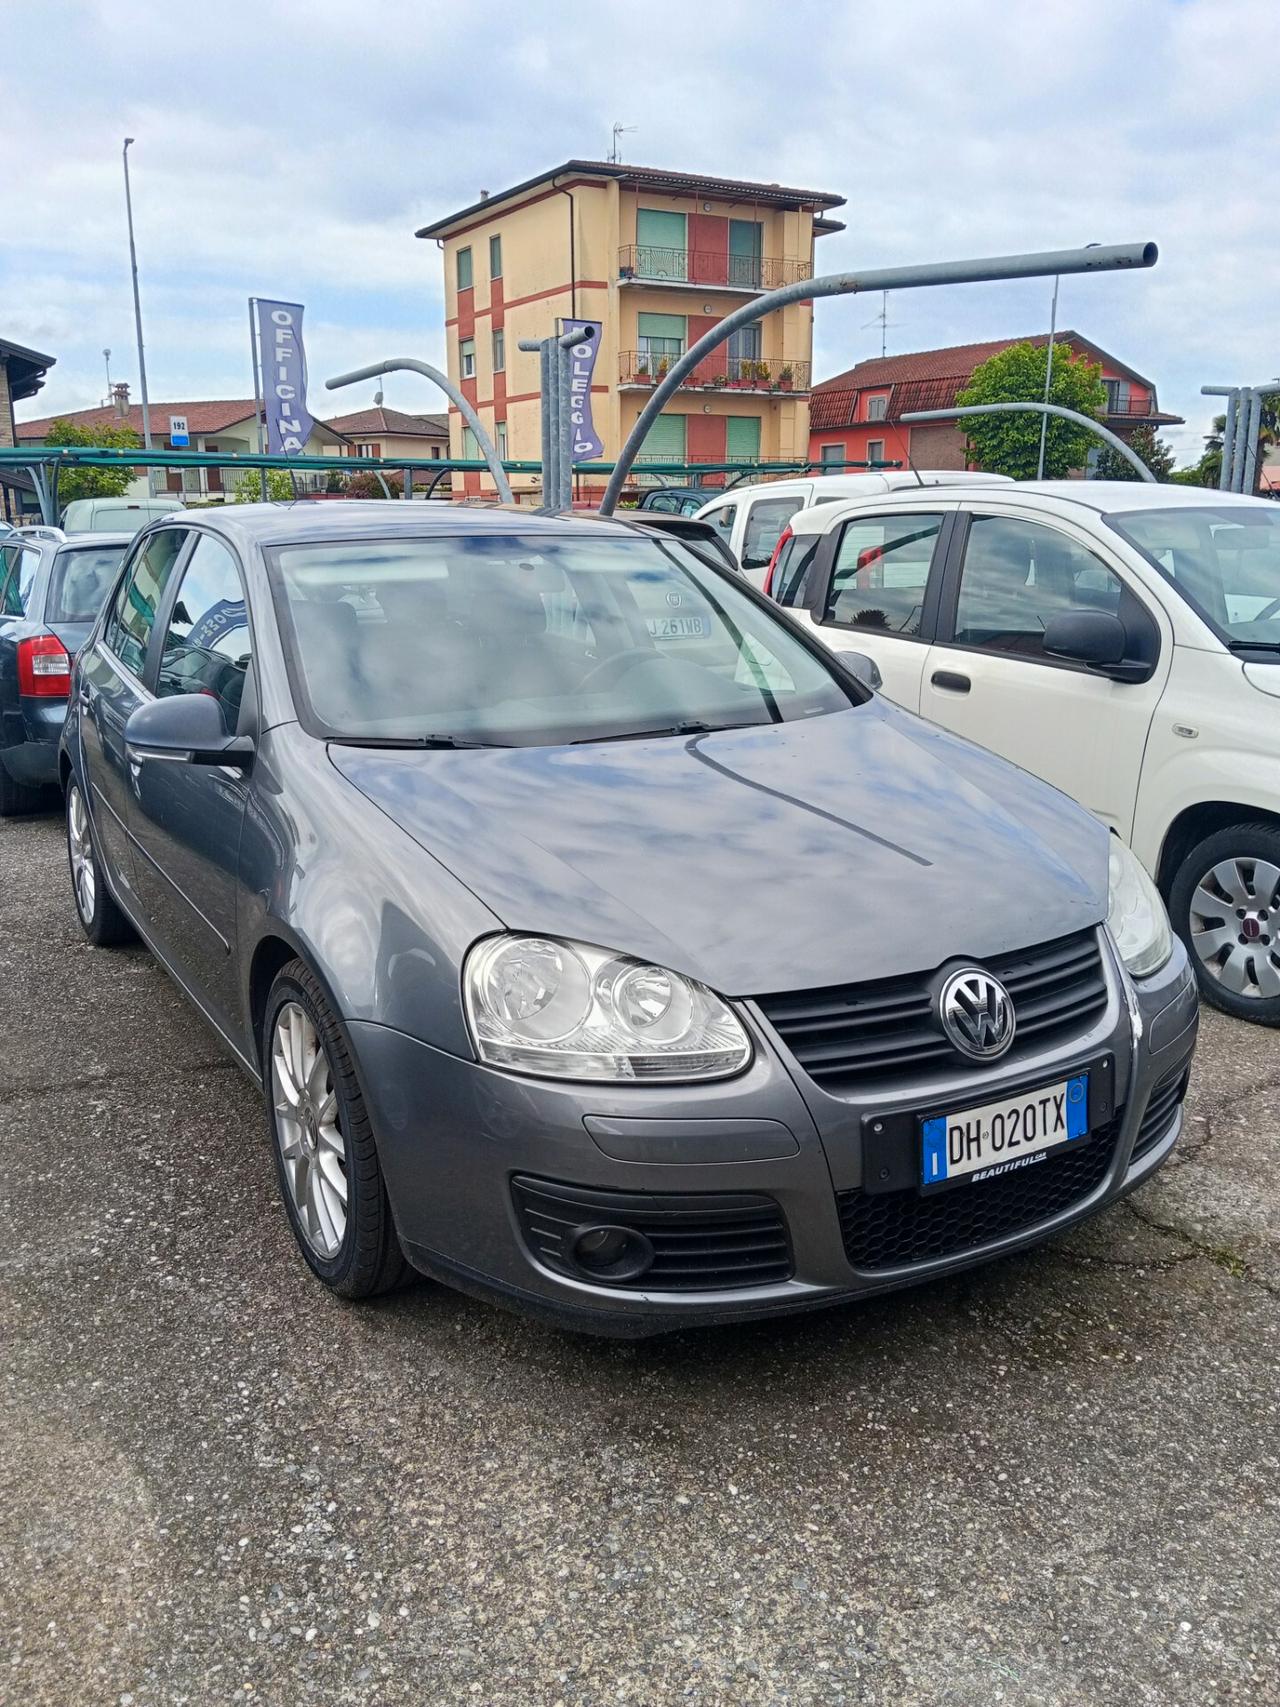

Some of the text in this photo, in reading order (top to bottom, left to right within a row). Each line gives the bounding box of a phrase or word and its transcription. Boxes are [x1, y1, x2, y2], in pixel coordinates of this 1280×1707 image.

[271, 310, 304, 456] OFFICINA
[570, 326, 594, 454] OLEGGIO
[173, 421, 186, 430] 192
[949, 1093, 1066, 1165] DH 020TX
[971, 1156, 1034, 1182] BEAUTIFUL
